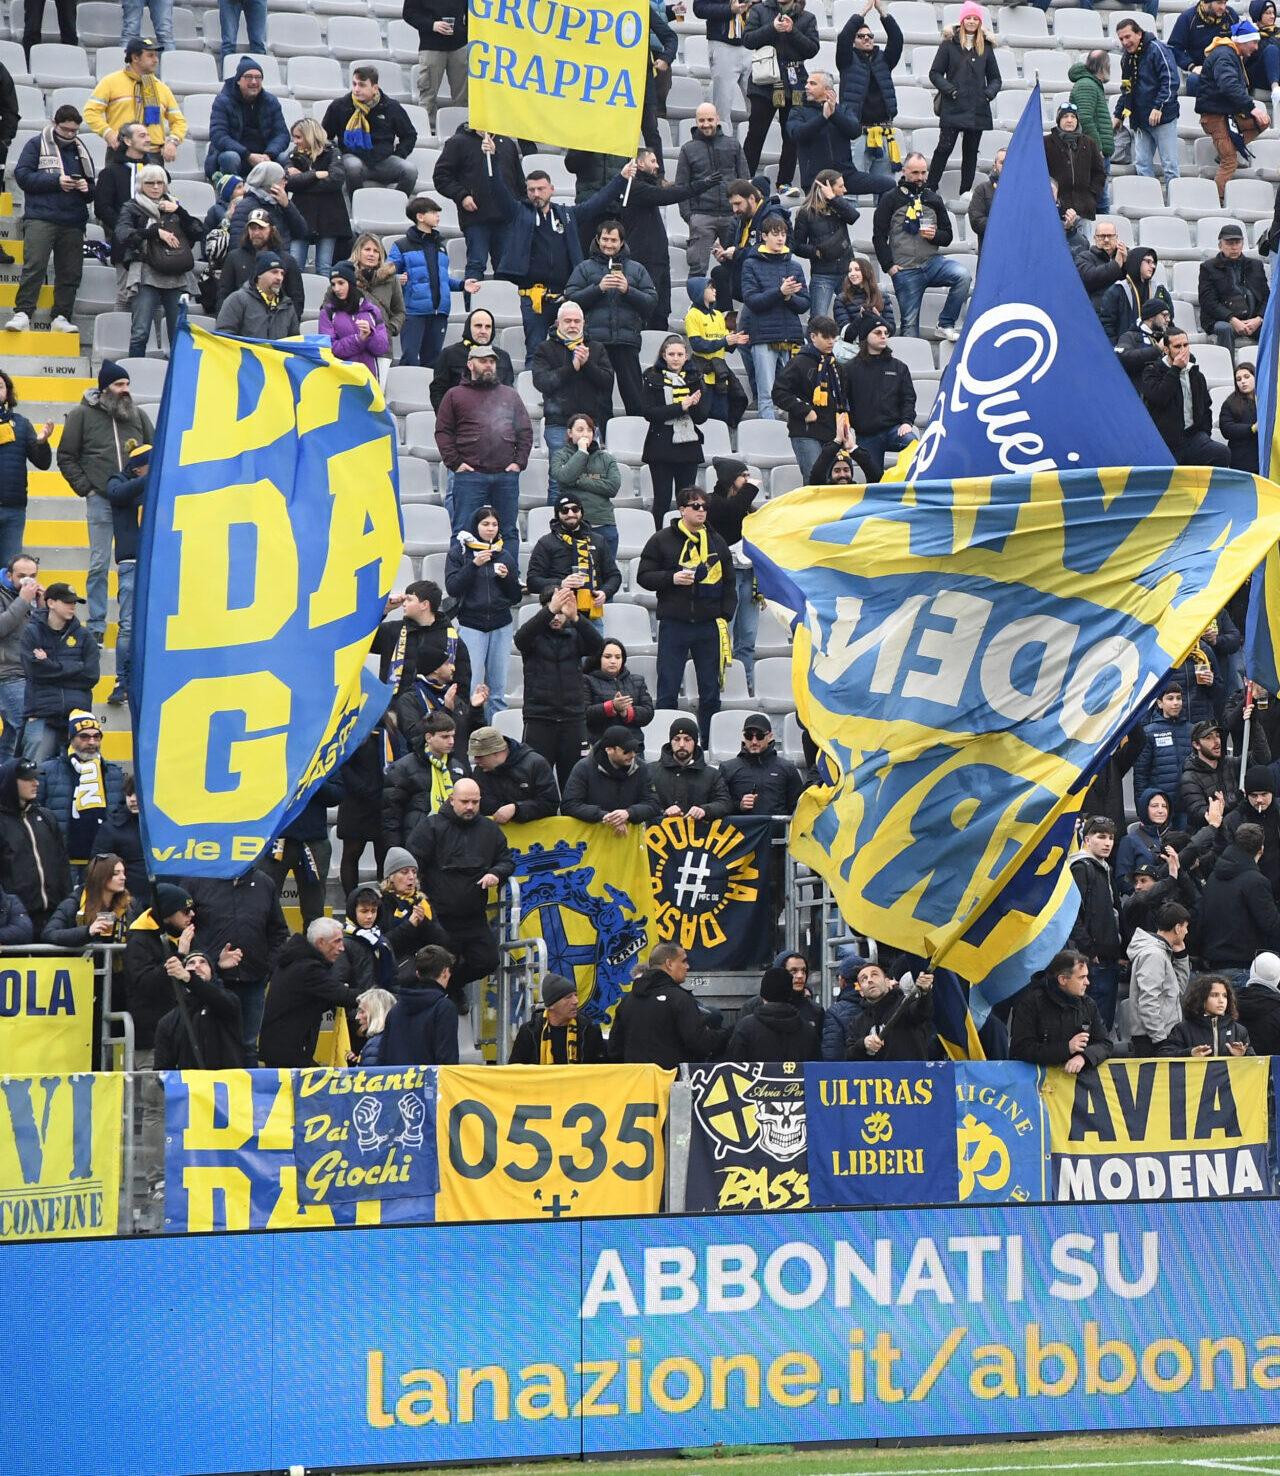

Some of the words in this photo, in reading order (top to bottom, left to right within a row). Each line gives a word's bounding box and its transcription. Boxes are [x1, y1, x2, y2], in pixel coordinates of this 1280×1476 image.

[469, 0, 642, 48] GRUPPO
[468, 40, 637, 108] GRAPPA
[43, 366, 54, 374] 16
[55, 366, 76, 375] ROW
[607, 934, 648, 966] PERVIA
[0, 969, 76, 1017] OLA
[300, 1065, 428, 1098] Distanti
[749, 1082, 782, 1098] Avia
[819, 1078, 933, 1106] ULTRAS
[1068, 1061, 1242, 1142] AVIA
[304, 1114, 350, 1143] Dai
[448, 1099, 659, 1184] 0535
[305, 1147, 412, 1201] Giochi
[832, 1149, 925, 1177] LIBERI
[1057, 1148, 1264, 1201] MODENA
[0, 1191, 104, 1238] CONFINE
[579, 1236, 1026, 1320] ABBONATI
[1048, 1230, 1160, 1300] SU
